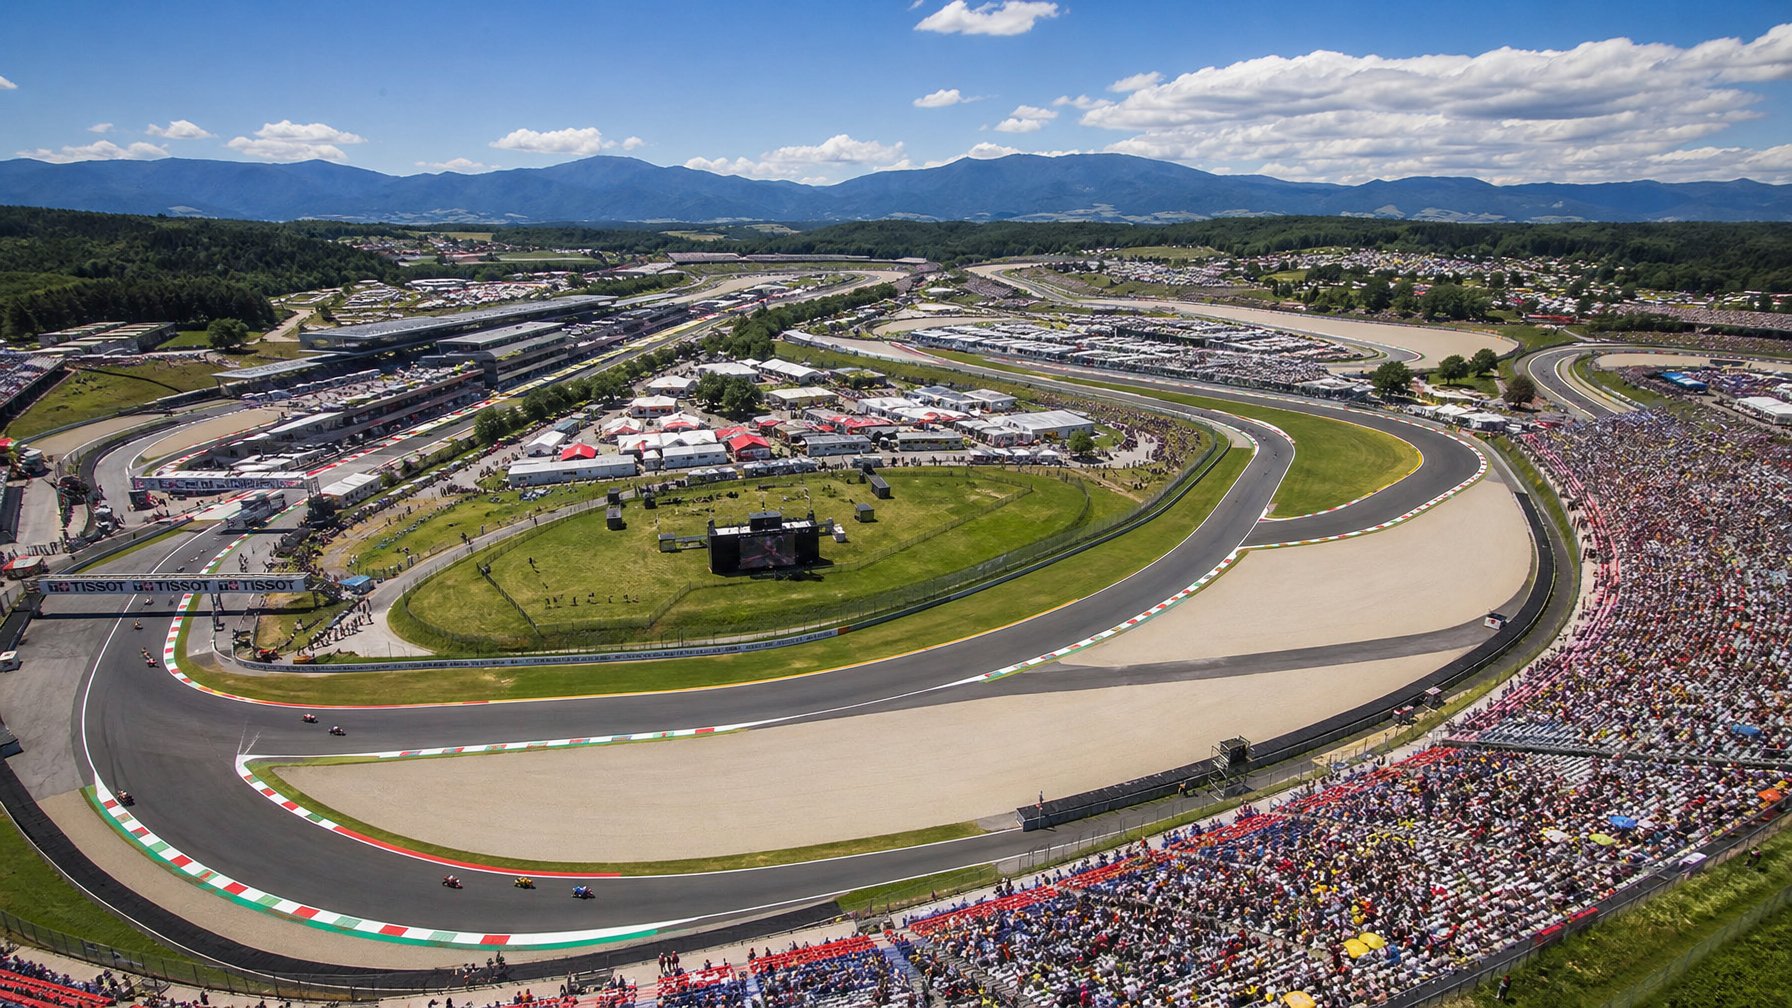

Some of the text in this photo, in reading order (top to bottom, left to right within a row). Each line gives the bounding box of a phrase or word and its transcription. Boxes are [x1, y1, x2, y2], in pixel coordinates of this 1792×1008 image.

[71, 581, 126, 592] TISSOT
[155, 581, 210, 592] TISSOT
[241, 580, 295, 591] TISSOT
